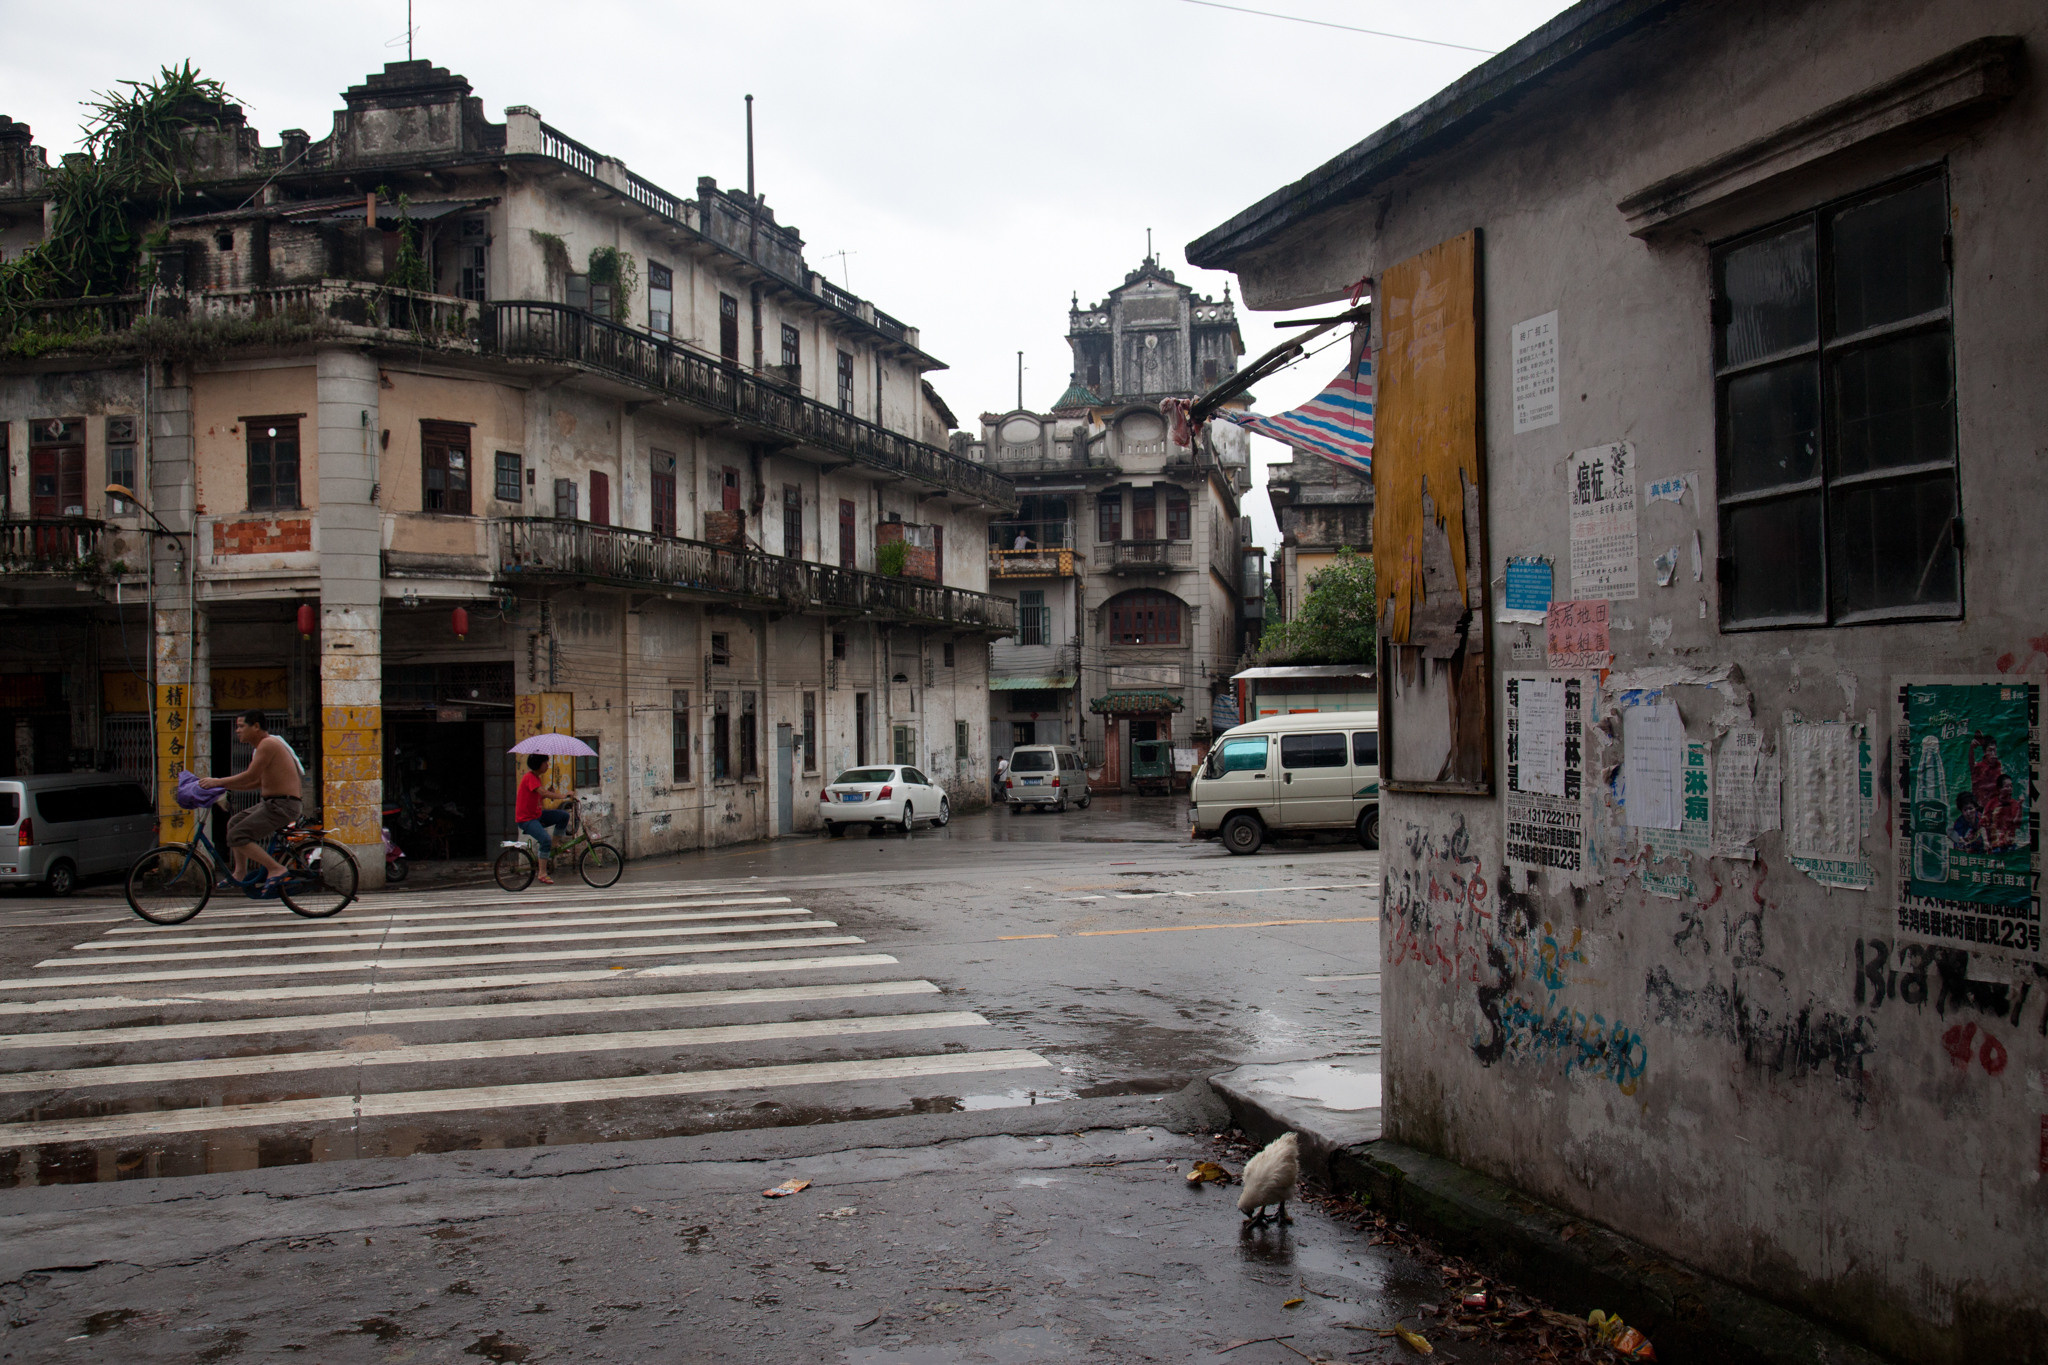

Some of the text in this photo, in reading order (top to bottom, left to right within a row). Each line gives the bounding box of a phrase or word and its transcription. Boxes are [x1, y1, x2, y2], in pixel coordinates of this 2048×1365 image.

[1737, 732, 1758, 748] 招聘
[1528, 808, 1582, 827] 13172221717
[1507, 841, 1581, 872] 华鸿电器城对面便见23号
[1950, 868, 2027, 888] 唯一指定饮用水
[1898, 906, 2041, 952] 华鸿电器城对面便见23号
